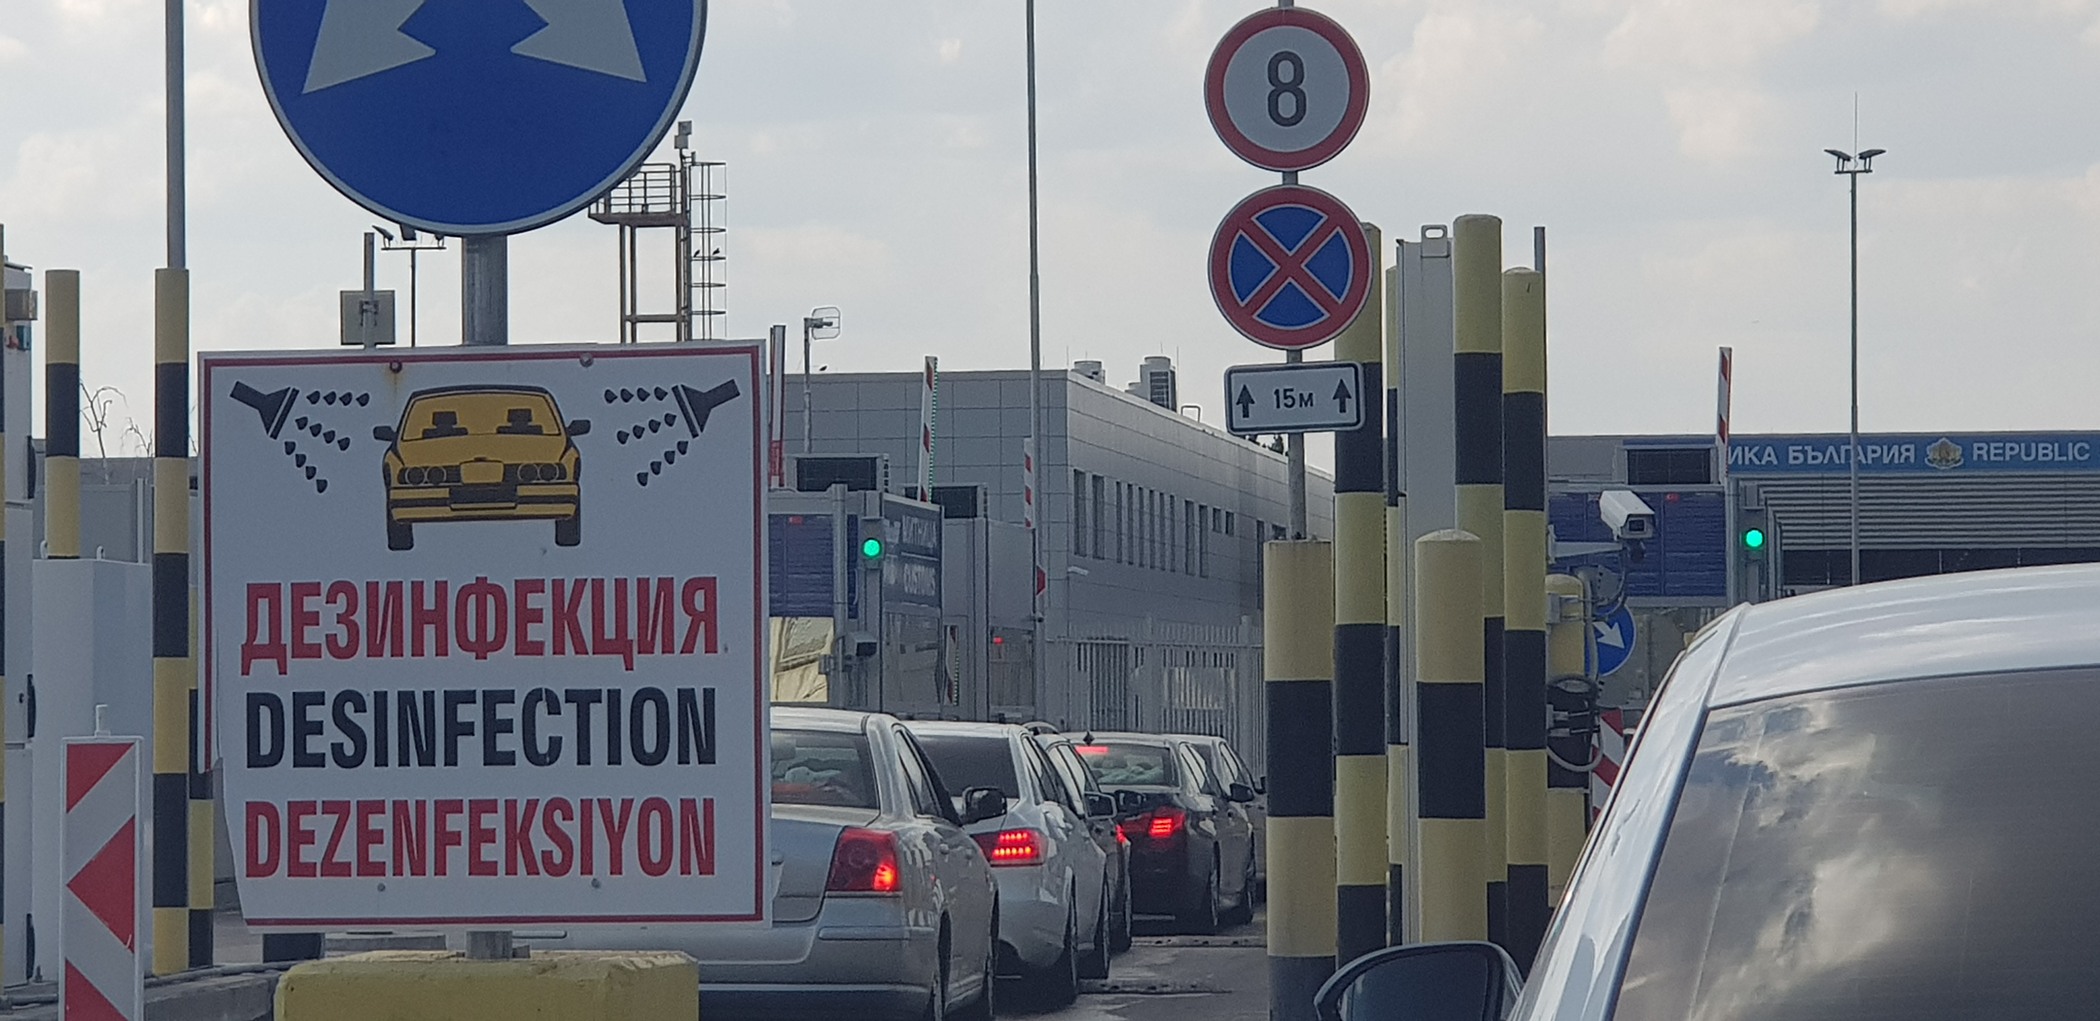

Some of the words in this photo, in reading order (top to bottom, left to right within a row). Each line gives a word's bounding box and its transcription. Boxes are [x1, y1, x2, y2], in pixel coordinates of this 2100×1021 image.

[1267, 51, 1307, 128] 8
[1728, 445, 1779, 466] ИКА
[1787, 443, 1915, 465] БЪЛГАРИЯ
[1972, 441, 2091, 462] REPUBLIC
[240, 576, 718, 676] ДЕЗИНФЕКЦИЯ
[245, 687, 717, 769] DESINFECTION
[245, 796, 716, 879] DEZENFEKSIYON
